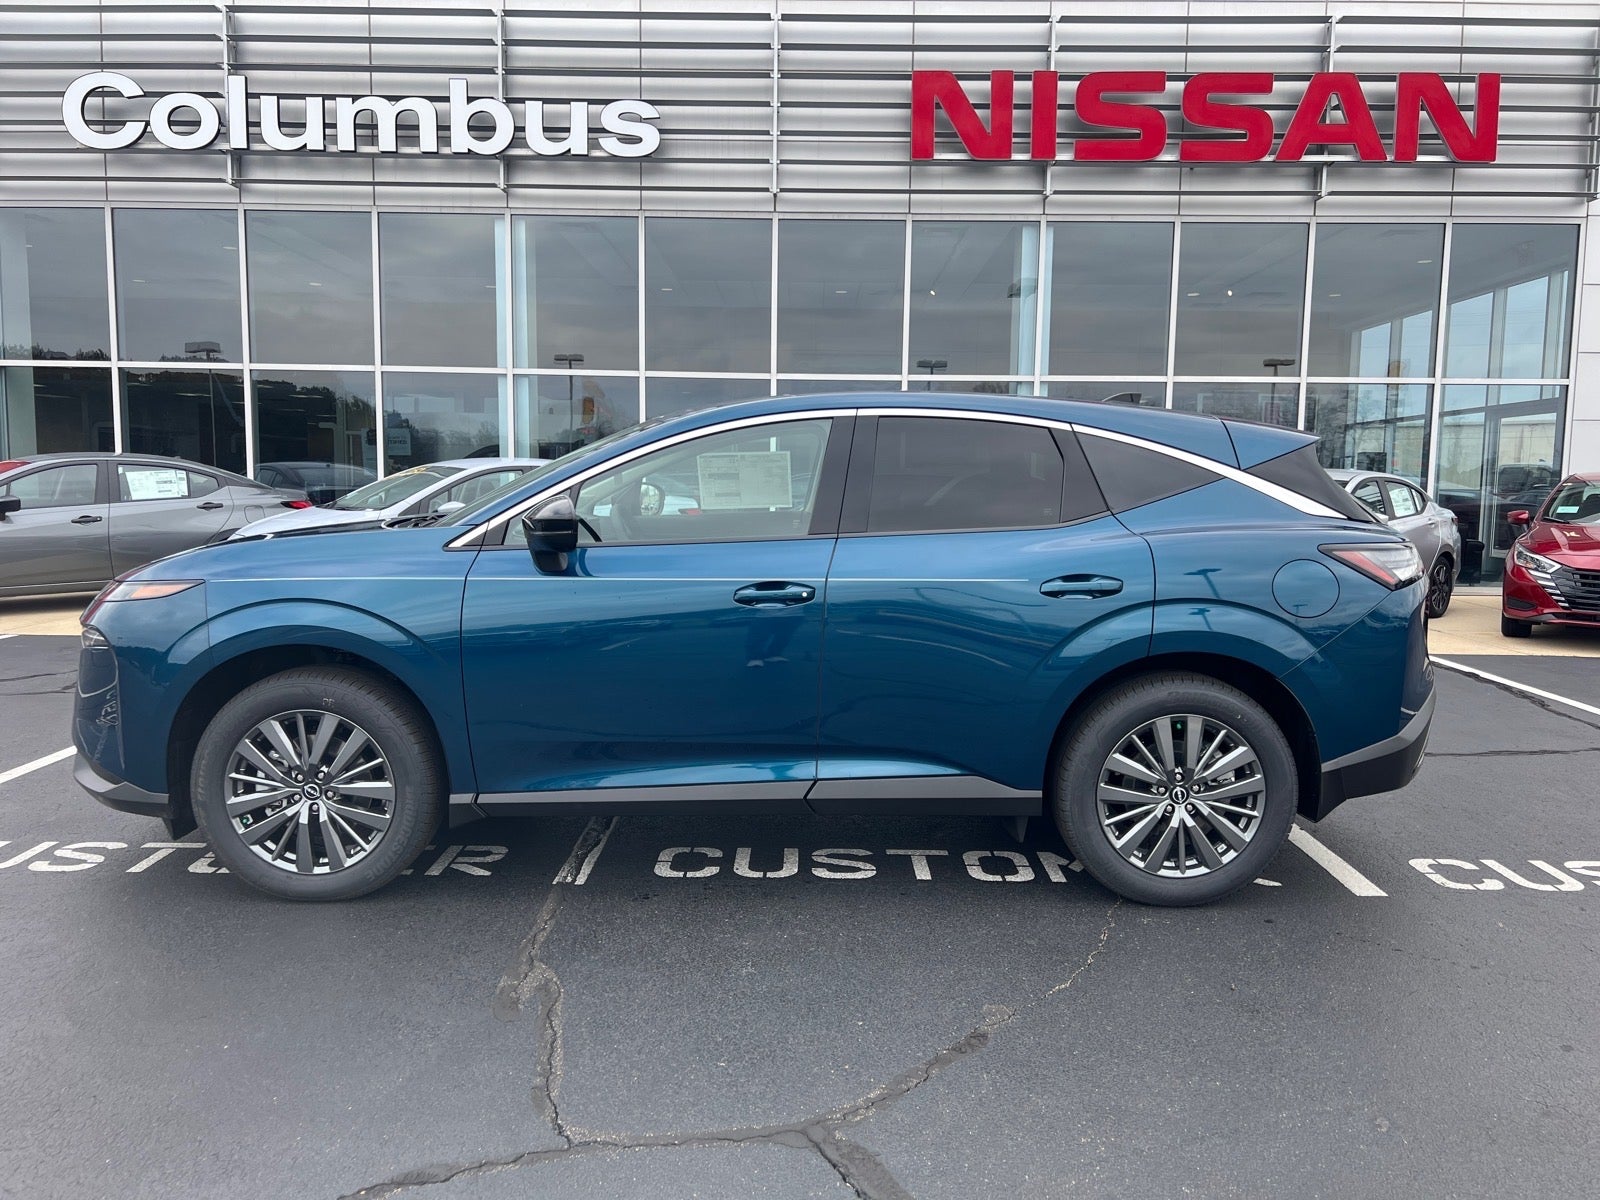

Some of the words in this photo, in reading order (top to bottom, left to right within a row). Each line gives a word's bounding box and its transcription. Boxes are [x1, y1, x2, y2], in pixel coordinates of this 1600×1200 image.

[61, 71, 662, 158] Columbus
[911, 69, 1501, 164] NISSAN
[653, 847, 1283, 887] CUSTO
